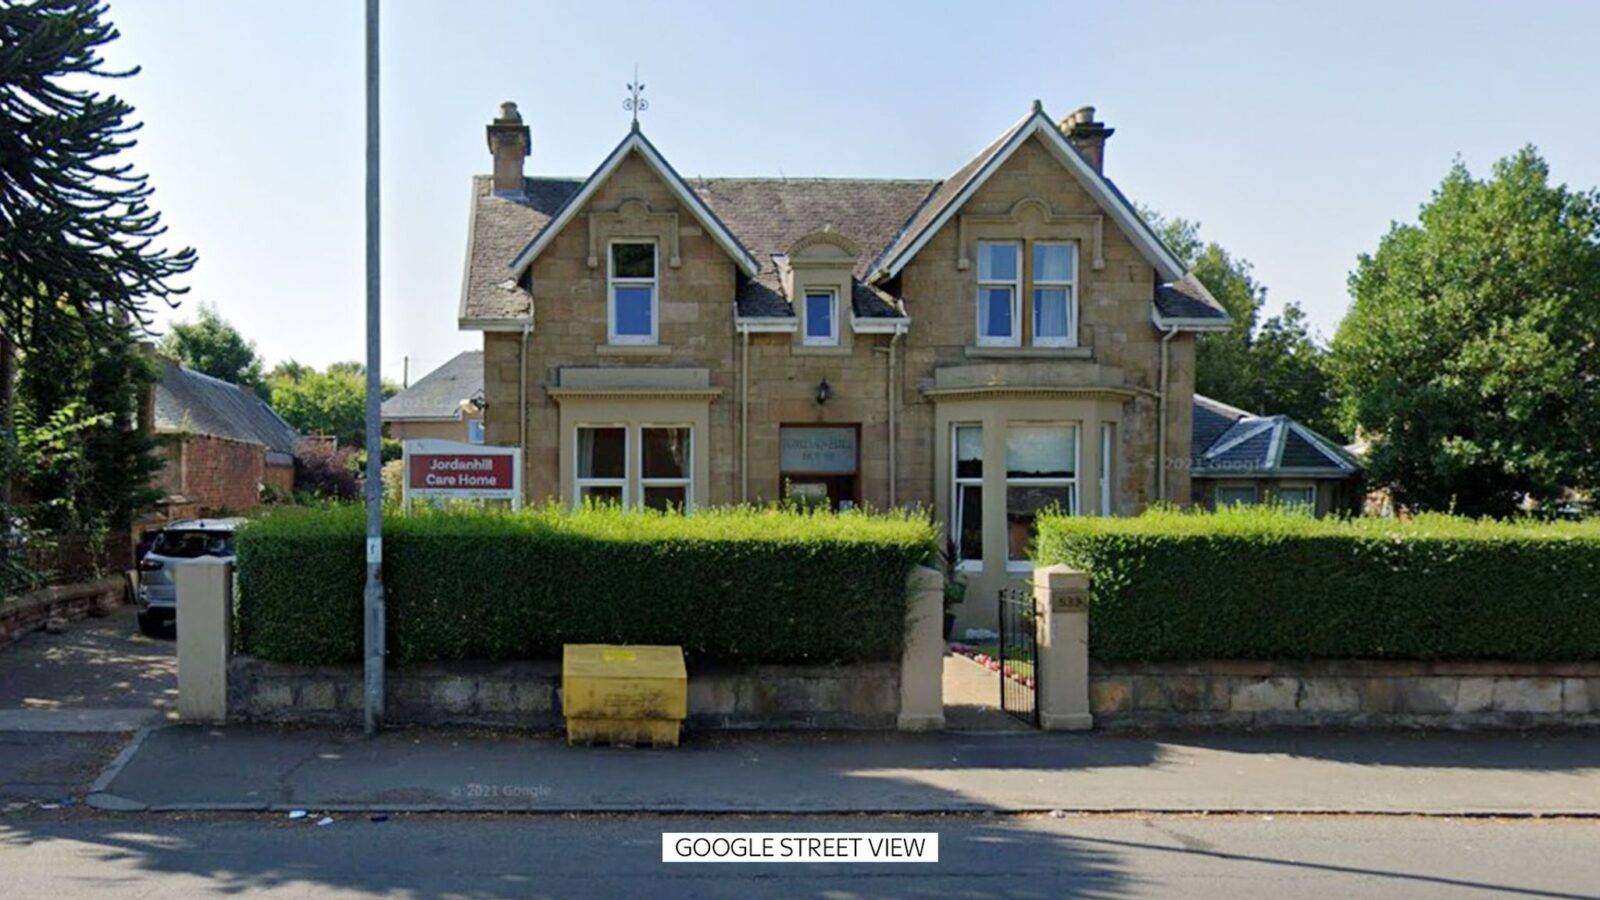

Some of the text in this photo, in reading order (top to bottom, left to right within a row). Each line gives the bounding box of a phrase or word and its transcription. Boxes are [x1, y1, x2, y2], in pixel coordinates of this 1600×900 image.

[429, 458, 493, 470] Jordanhill
[425, 473, 497, 486] Care Home
